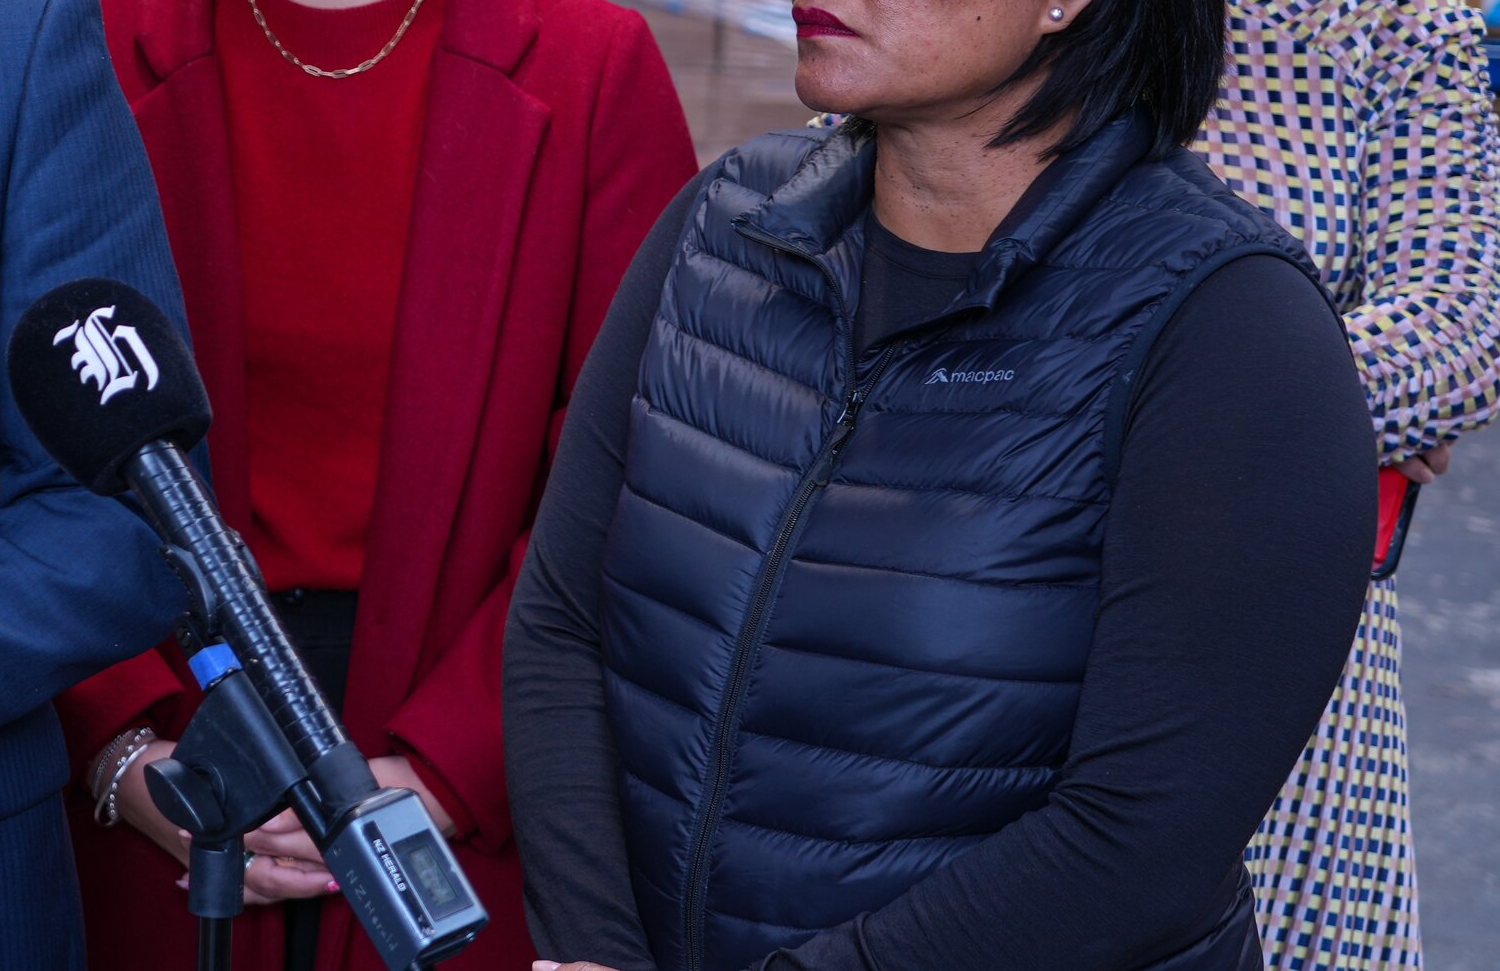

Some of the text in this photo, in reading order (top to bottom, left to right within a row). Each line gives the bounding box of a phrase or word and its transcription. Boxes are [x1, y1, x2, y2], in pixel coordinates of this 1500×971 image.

[950, 369, 1015, 385] macpac
[372, 838, 407, 893] NZ HERALD
